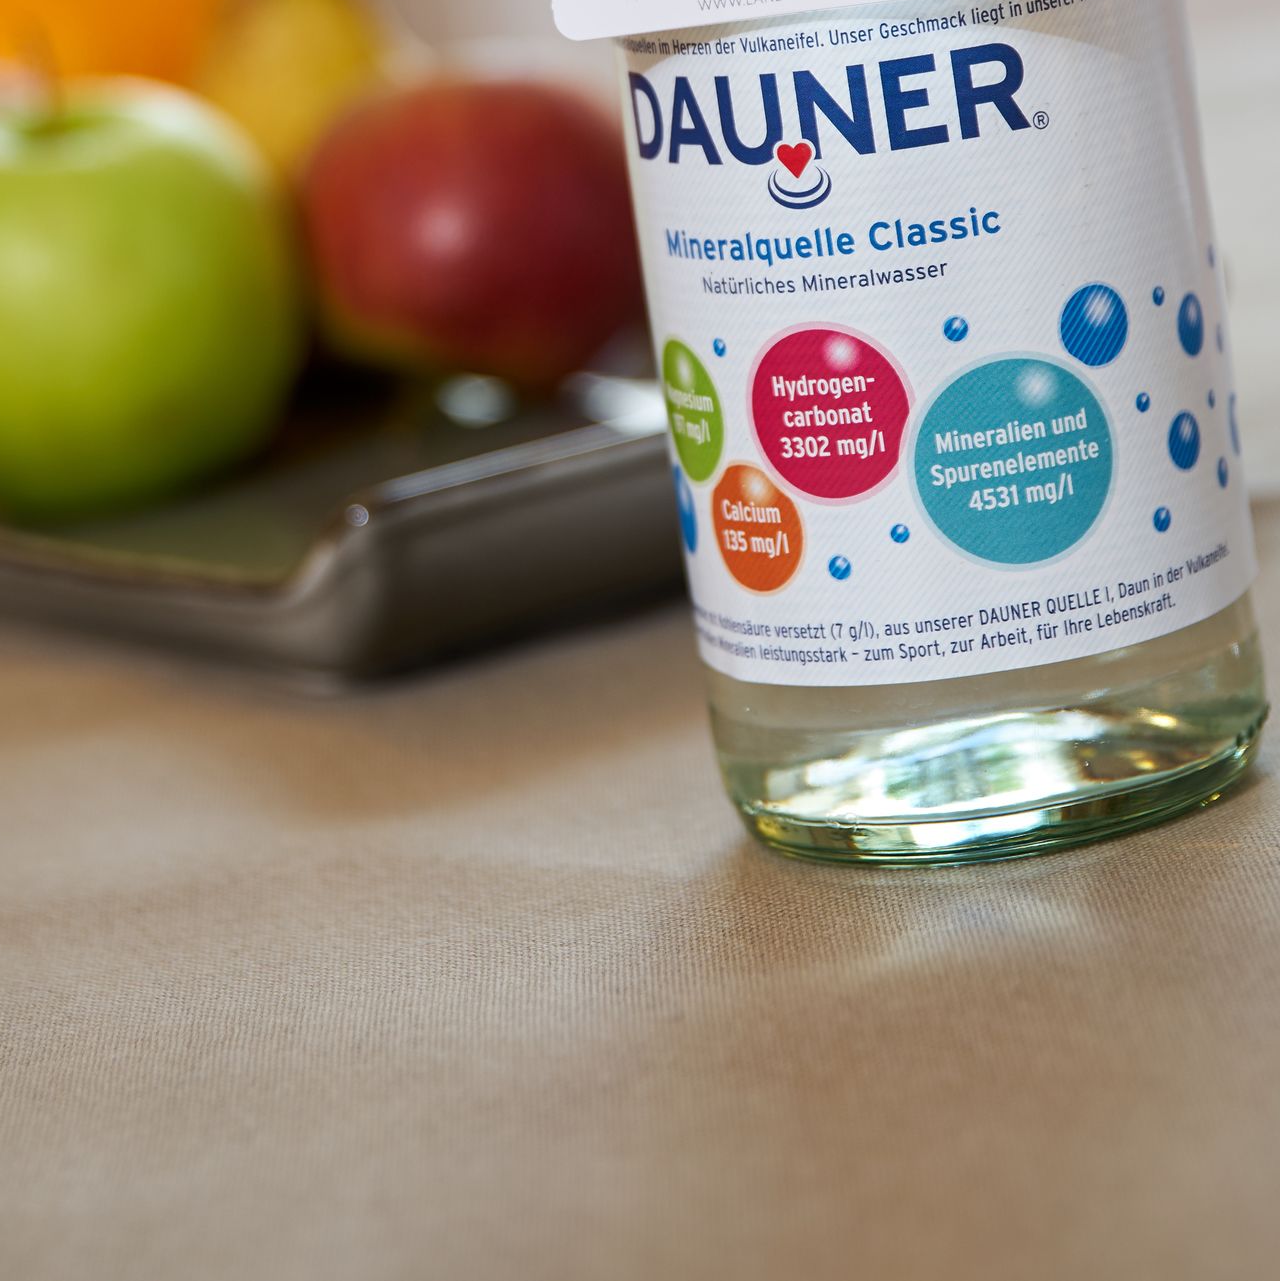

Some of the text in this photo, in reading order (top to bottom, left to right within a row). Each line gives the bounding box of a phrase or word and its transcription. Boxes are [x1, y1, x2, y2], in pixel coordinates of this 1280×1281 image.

[658, 38, 671, 55] im
[672, 39, 712, 56] Herzen
[716, 39, 735, 55] der
[739, 30, 824, 54] Vulkaneifel.
[829, 26, 874, 46] Unser
[879, 11, 967, 40] Geschmack
[971, 4, 1005, 26] liegt
[1009, 1, 1022, 17] in
[628, 42, 1031, 167] DAUNER
[666, 207, 1002, 267] Mineralquelle Classic
[702, 260, 948, 295] Natürliches Mineralwasser
[772, 375, 875, 402] Hydrogen-
[783, 401, 872, 428] carbonat
[935, 407, 1088, 454] Mineralien und
[780, 429, 885, 460] 3302 mg/l
[930, 439, 1099, 489] Spurenelemente
[722, 499, 781, 523] Calcium
[969, 473, 1074, 511] 4531 mg/l
[723, 529, 790, 558] 135 mg/l
[774, 624, 826, 639] versetzt
[831, 623, 843, 641] (7
[884, 622, 910, 636] aus
[915, 614, 974, 634] unserer
[979, 601, 1041, 626] DAUNER
[1046, 588, 1102, 615] QUELLE
[1118, 578, 1150, 599] Daun
[1153, 573, 1164, 588] in
[1167, 565, 1184, 583] der
[759, 645, 848, 666] leistungsstark
[864, 647, 894, 662] zum
[899, 639, 946, 662] Sport,
[950, 638, 974, 654] zur
[981, 628, 1033, 650] Arbeit,
[1037, 623, 1059, 641] für
[1064, 618, 1092, 636] Ihre
[1097, 593, 1176, 628] Lebenskraft.
